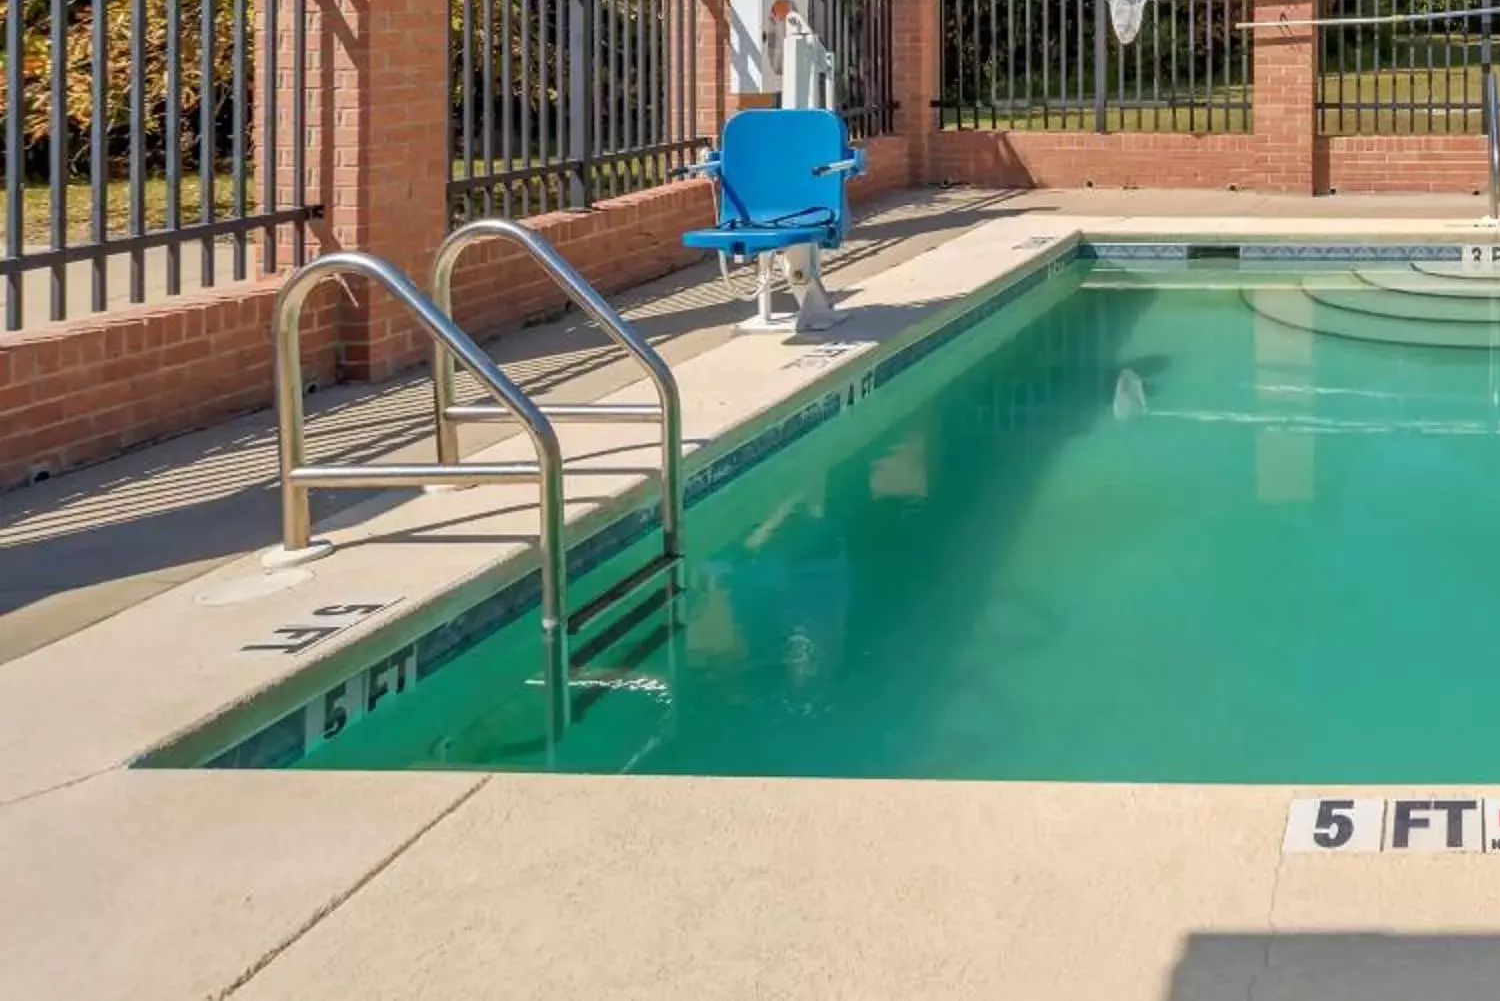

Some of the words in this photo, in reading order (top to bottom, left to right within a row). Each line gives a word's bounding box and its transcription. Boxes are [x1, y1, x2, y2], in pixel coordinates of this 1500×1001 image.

[312, 603, 387, 616] 5
[239, 624, 342, 654] FT
[322, 681, 347, 740] 5
[367, 642, 415, 712] FT
[1312, 799, 1355, 849] 5
[1391, 799, 1478, 849] FT
